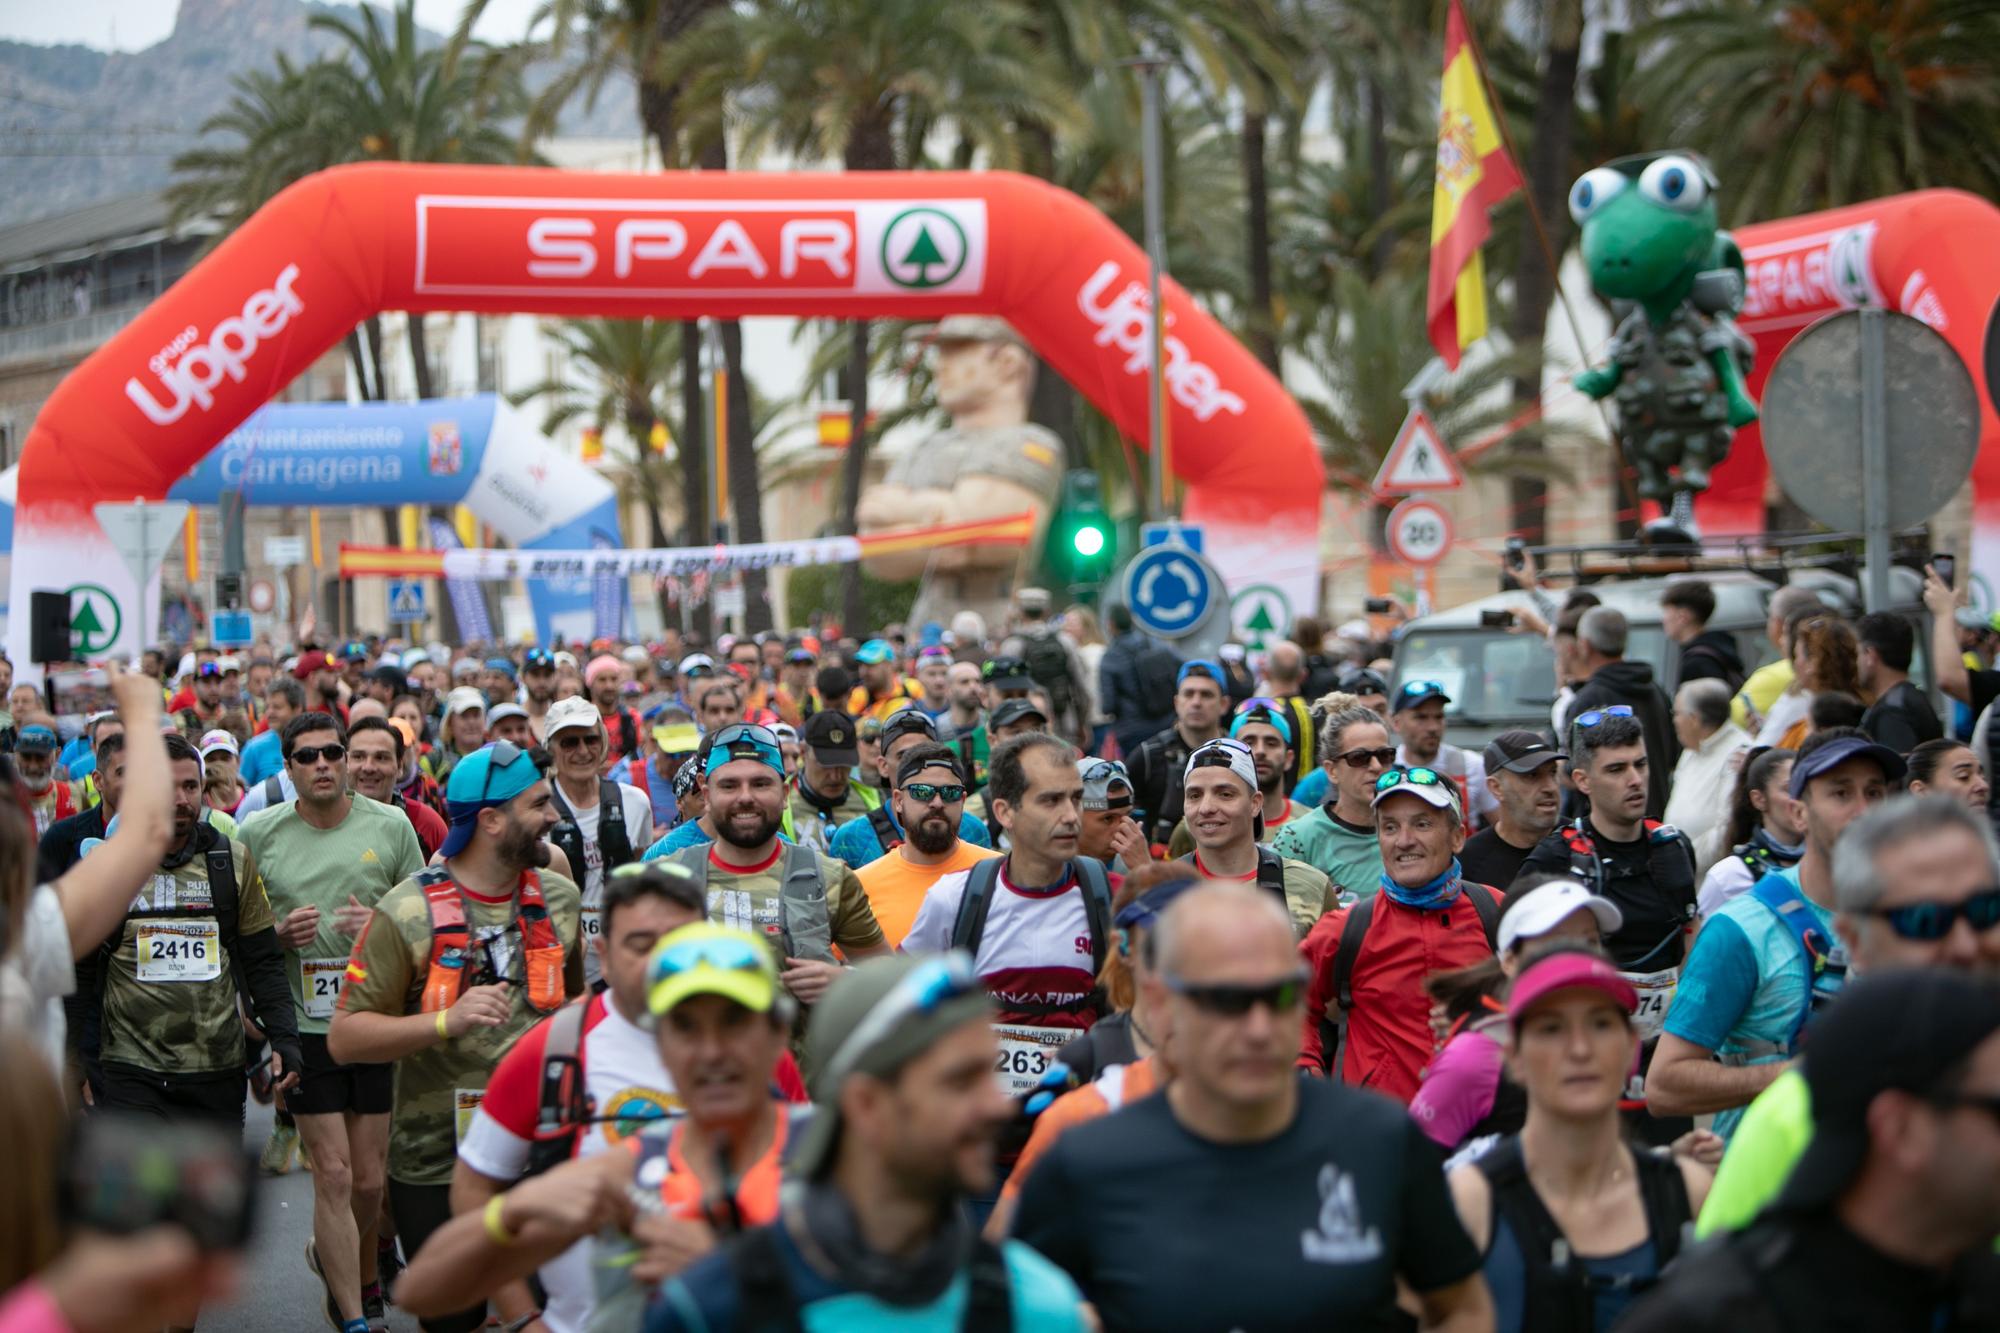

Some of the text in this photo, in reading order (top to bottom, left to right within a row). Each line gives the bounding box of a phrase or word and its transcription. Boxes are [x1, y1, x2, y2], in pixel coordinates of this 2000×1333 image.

[527, 217, 853, 280] SPAR
[1744, 249, 1834, 317] SPAR
[125, 262, 305, 426] Upper
[220, 449, 403, 491] Cartagena
[1406, 521, 1441, 545] 20
[533, 558, 584, 573] RUTA
[594, 559, 620, 573] DE
[152, 941, 206, 959] 2416
